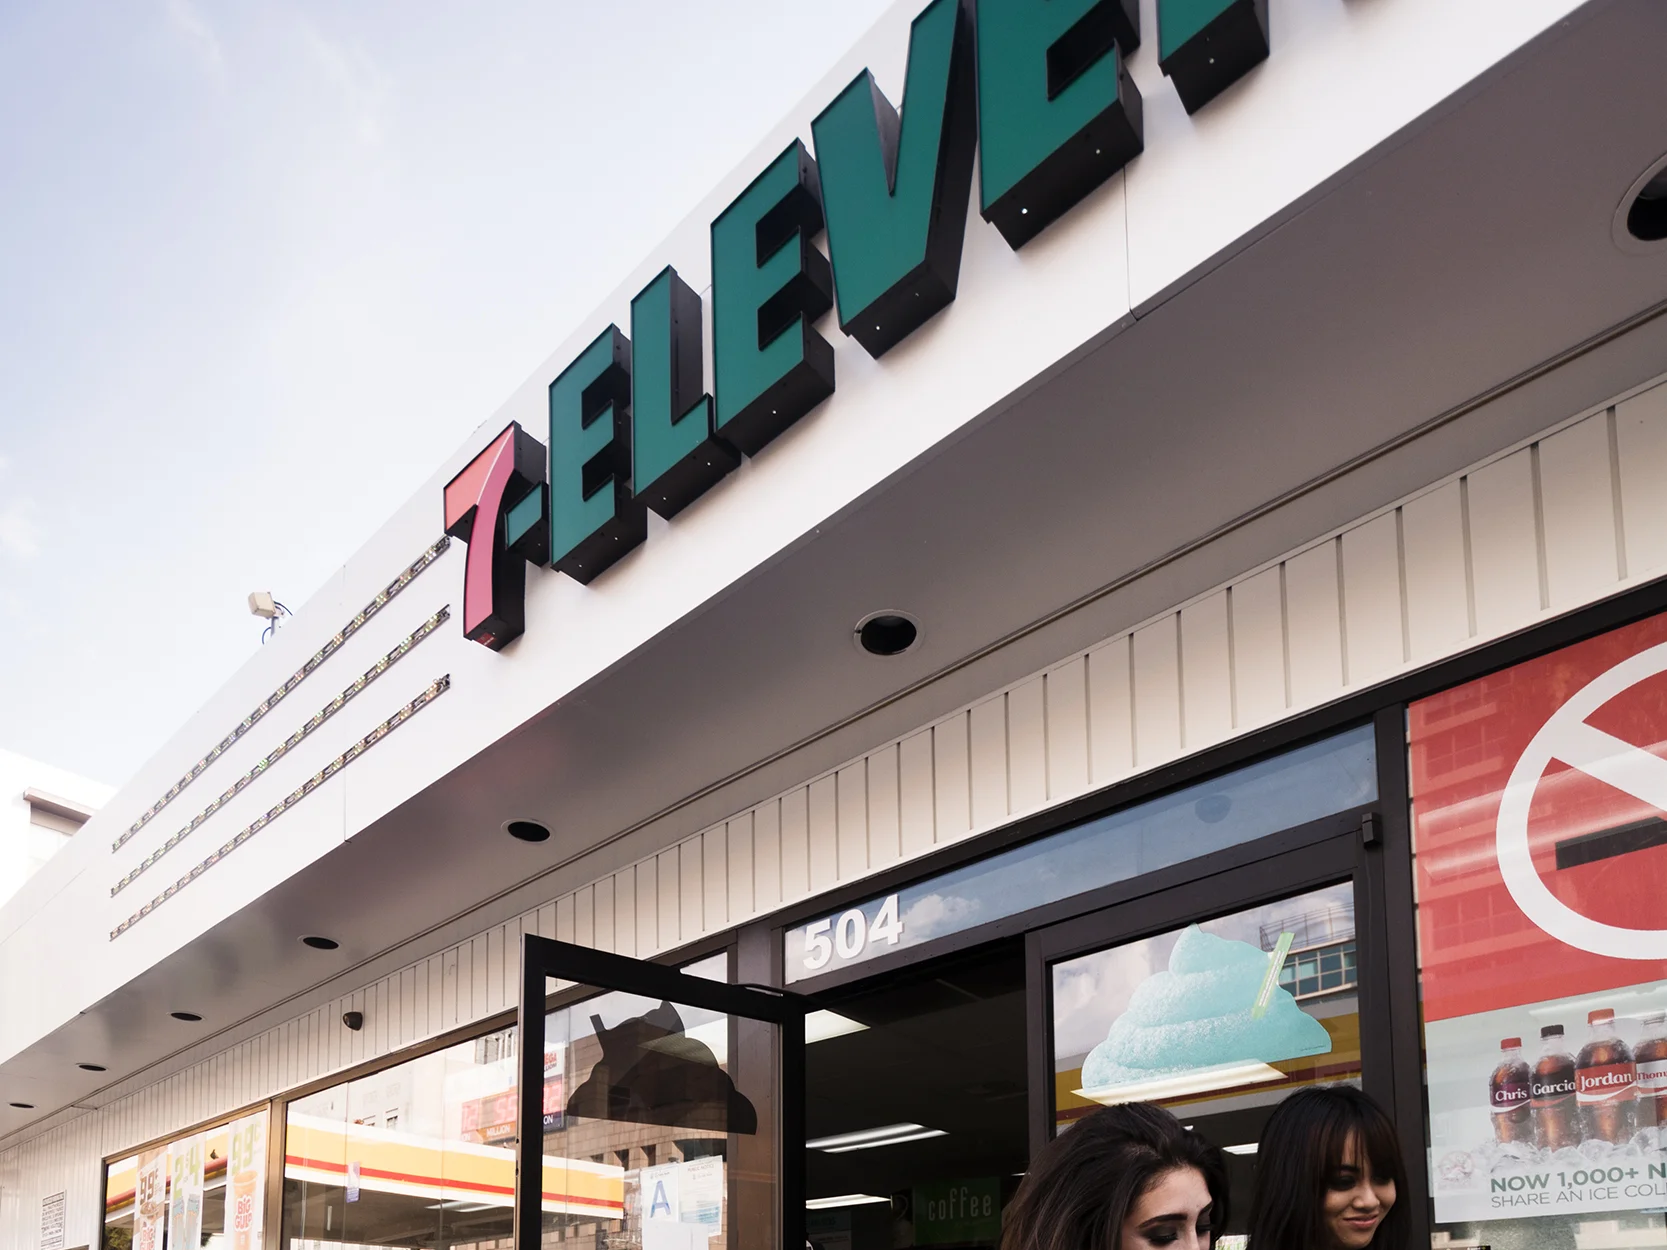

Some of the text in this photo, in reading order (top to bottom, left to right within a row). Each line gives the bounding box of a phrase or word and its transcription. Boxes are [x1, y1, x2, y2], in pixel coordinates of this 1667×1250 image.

[443, 0, 1270, 652] 7-ELEVE
[802, 893, 903, 970] 504
[1495, 1088, 1527, 1101] Chris
[1533, 1080, 1576, 1095] Garcia
[1580, 1072, 1632, 1092] Jordan
[1491, 1174, 1550, 1193] NOW
[1557, 1167, 1639, 1190] 1,000+
[650, 1180, 671, 1218] A
[928, 1187, 992, 1221] coffee
[1492, 1184, 1667, 1208] SHARE AN ICE COL
[235, 1213, 252, 1230] GULP
